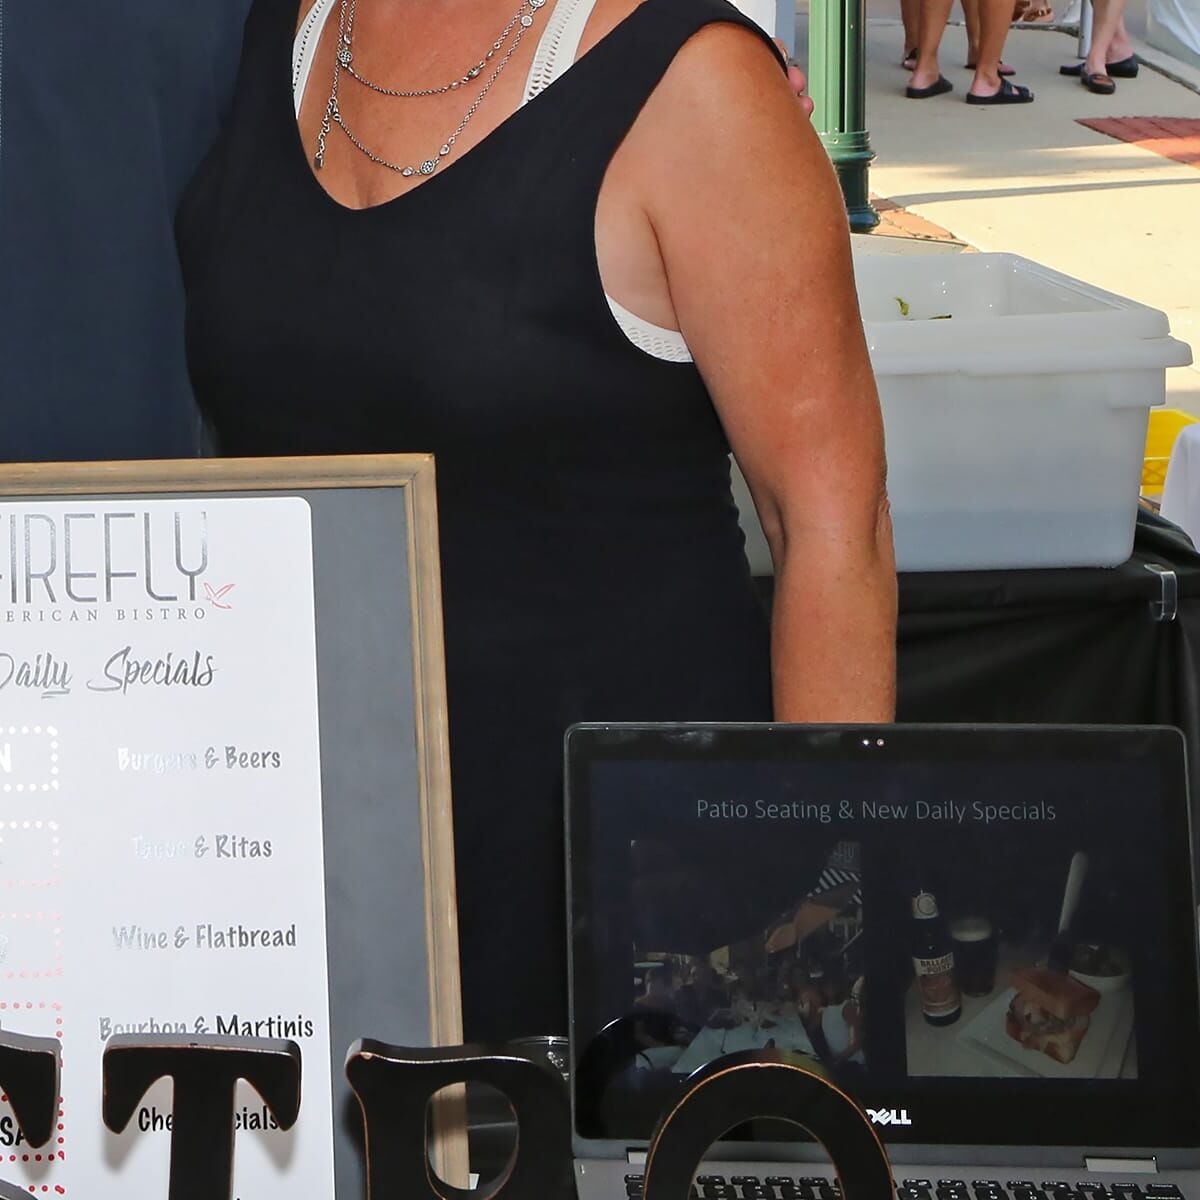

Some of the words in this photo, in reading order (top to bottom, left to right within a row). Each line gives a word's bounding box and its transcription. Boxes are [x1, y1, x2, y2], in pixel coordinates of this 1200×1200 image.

[117, 607, 206, 621] BISTRO
[86, 646, 219, 695] Specials
[204, 746, 220, 769] &
[224, 745, 281, 769] Beers
[696, 799, 748, 819] Patio
[755, 800, 831, 823] Seating
[838, 800, 854, 820] &
[862, 801, 908, 820] New
[916, 800, 966, 824] Daily
[972, 801, 1056, 824] Specials
[194, 835, 209, 858] &
[215, 834, 273, 858] Ritas
[112, 925, 168, 949] Wine
[174, 926, 190, 949] &
[196, 924, 296, 949] Flatbread
[194, 1015, 209, 1035] &
[216, 1014, 314, 1038] Martinis
[865, 1108, 912, 1126] DELL
